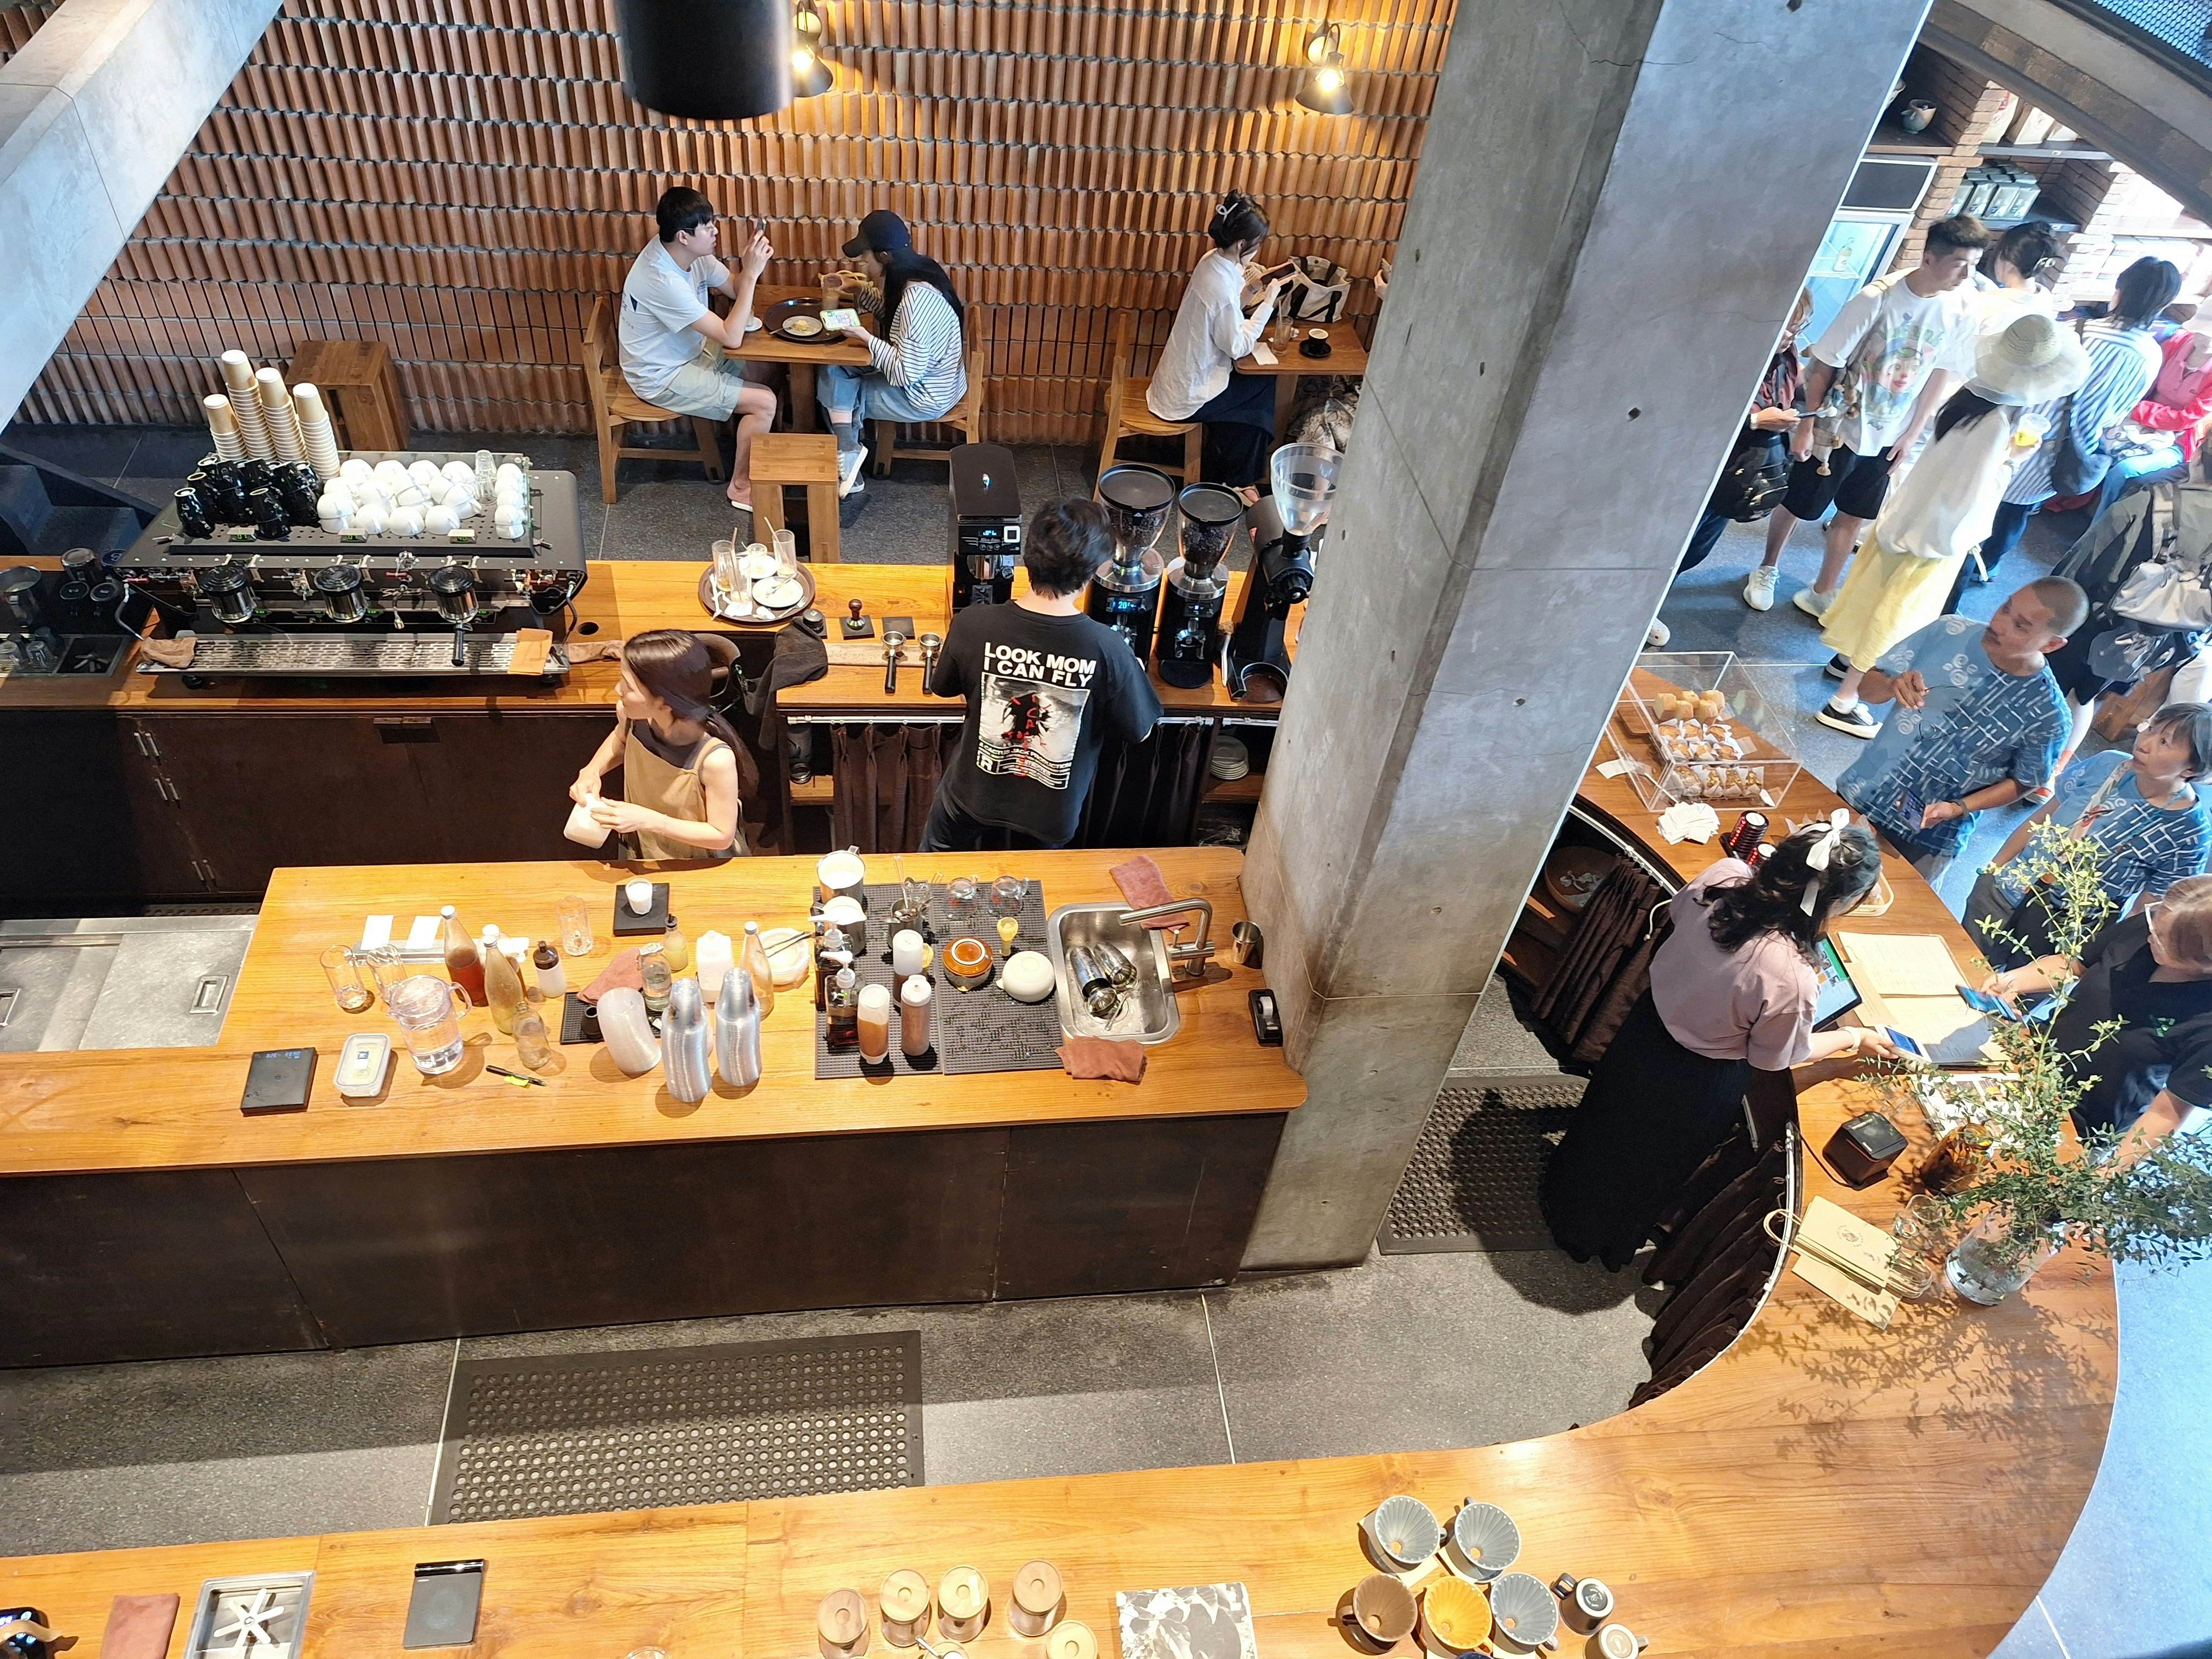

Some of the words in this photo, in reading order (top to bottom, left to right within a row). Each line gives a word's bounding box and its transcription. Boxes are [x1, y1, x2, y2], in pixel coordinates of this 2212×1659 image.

[985, 642, 1041, 665] LOOK
[1046, 654, 1097, 674] MOM
[983, 657, 990, 671] I
[997, 660, 1045, 679] CAN
[1051, 670, 1093, 687] FLY
[980, 755, 993, 772] R
[983, 745, 1010, 755] CACTUS
[1030, 751, 1072, 769] PRODUCTION
